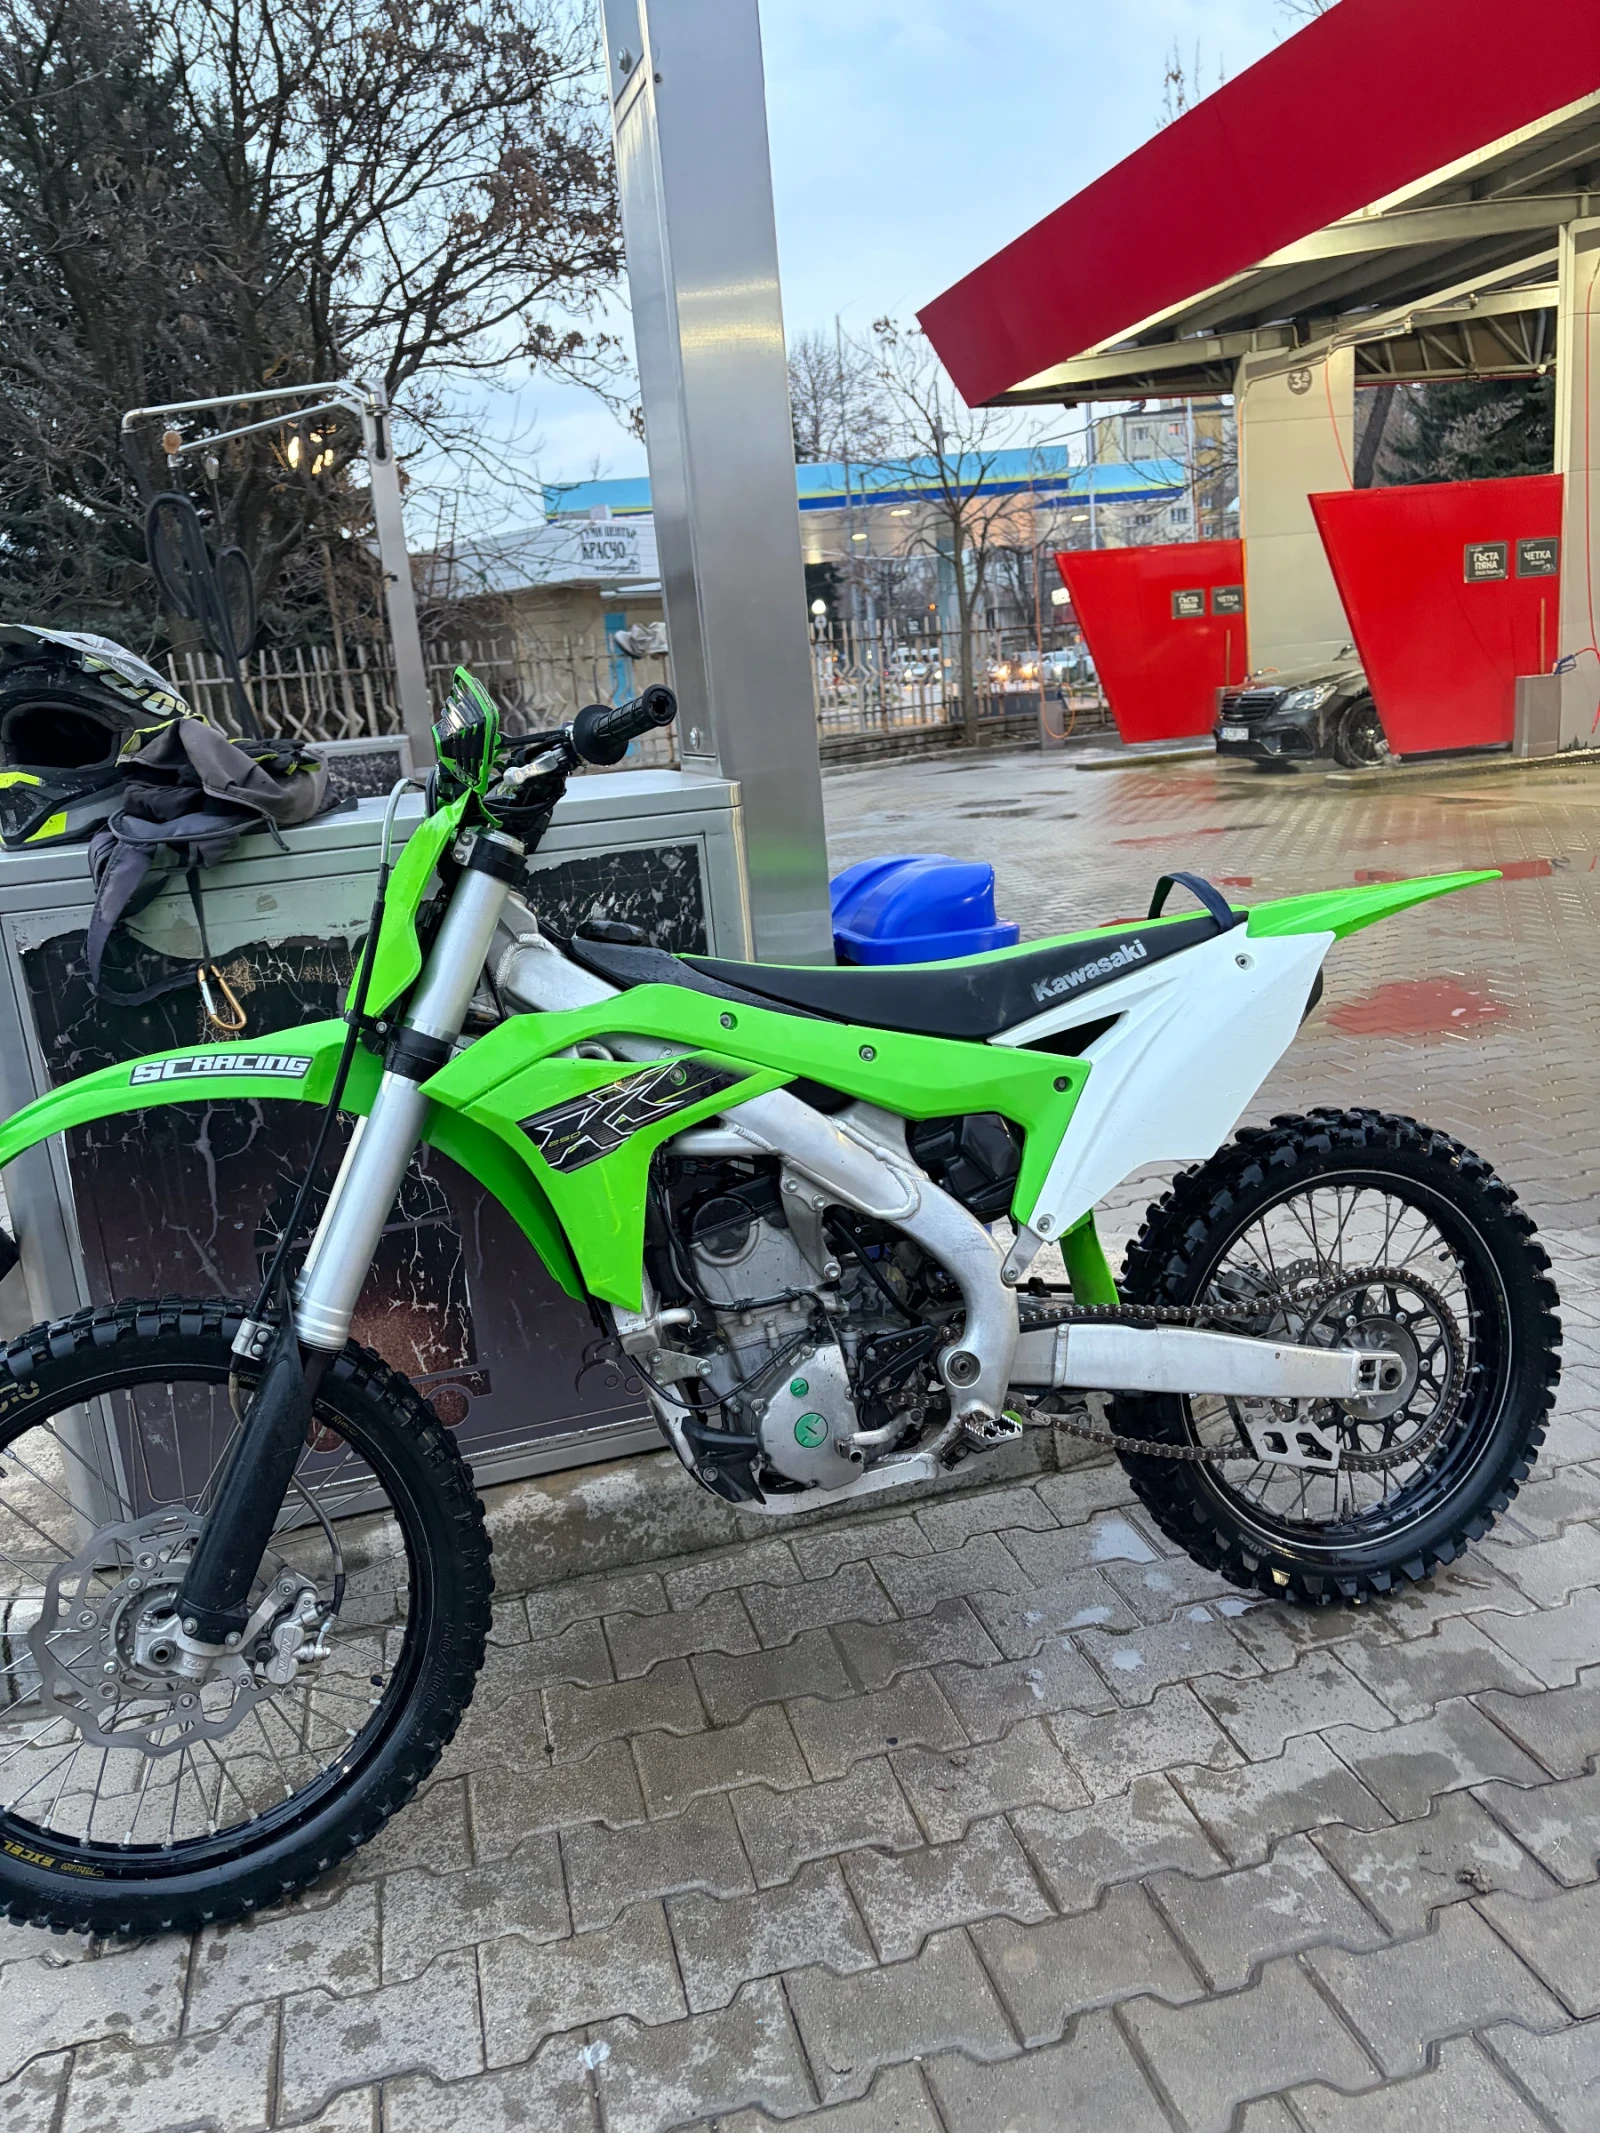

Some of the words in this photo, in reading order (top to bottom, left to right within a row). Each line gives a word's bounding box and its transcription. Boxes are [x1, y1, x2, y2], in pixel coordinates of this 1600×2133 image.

[1523, 549, 1552, 560] ЧЕТКА
[1031, 938, 1148, 1002] Kawasaki
[3, 1840, 56, 1868] EXCEL
